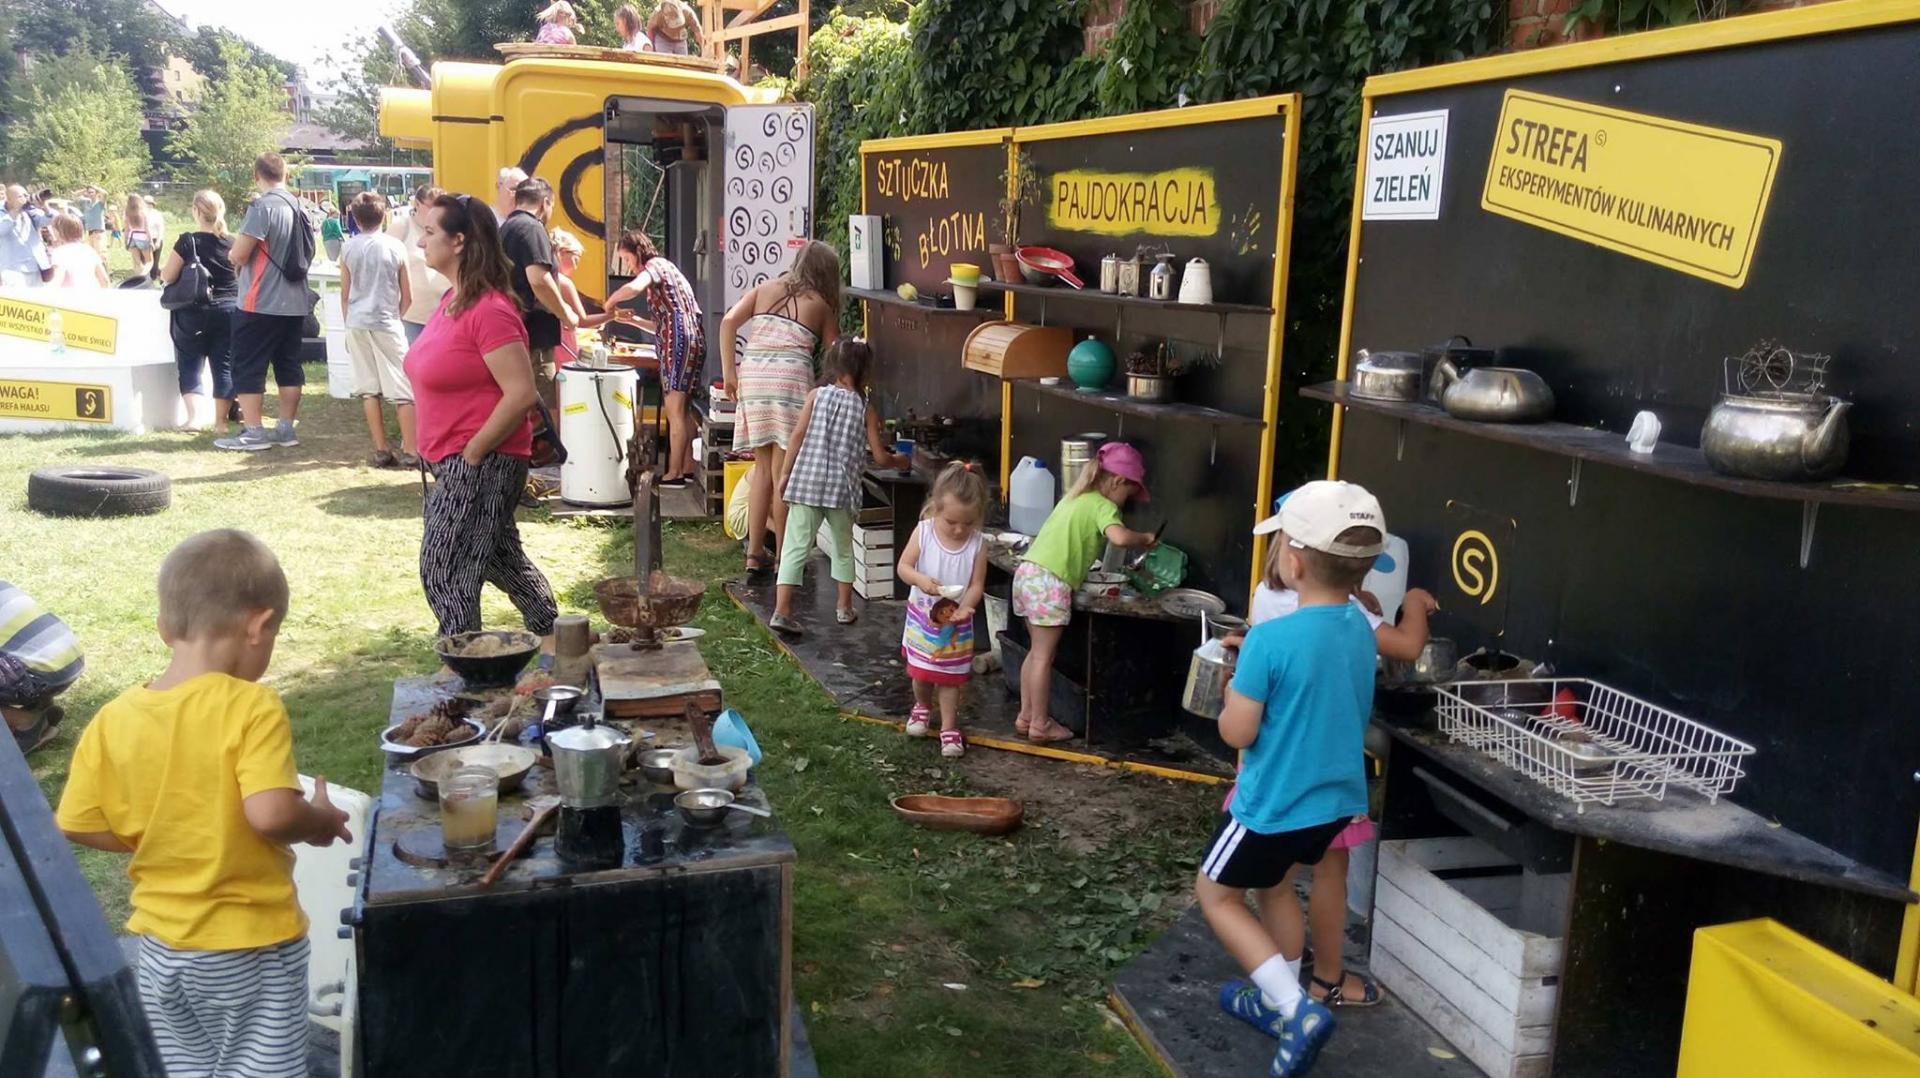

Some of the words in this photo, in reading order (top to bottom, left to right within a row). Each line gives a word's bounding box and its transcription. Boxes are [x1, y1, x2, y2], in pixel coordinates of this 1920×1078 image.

[1374, 129, 1438, 161] SZANUJ
[1506, 118, 1589, 173] STREFA
[877, 158, 949, 202] SZTUCZKA
[1373, 166, 1431, 203] ZIELEŃ
[1057, 179, 1207, 225] PAJDOKRACJA
[1499, 165, 1616, 217] EKSPERYMENTÓW
[1616, 198, 1735, 252] KULINARNYCH
[918, 211, 985, 270] BŁOTNA
[0, 304, 45, 325] UWAGA!
[0, 385, 39, 400] WAGA!
[0, 402, 19, 411] REFA
